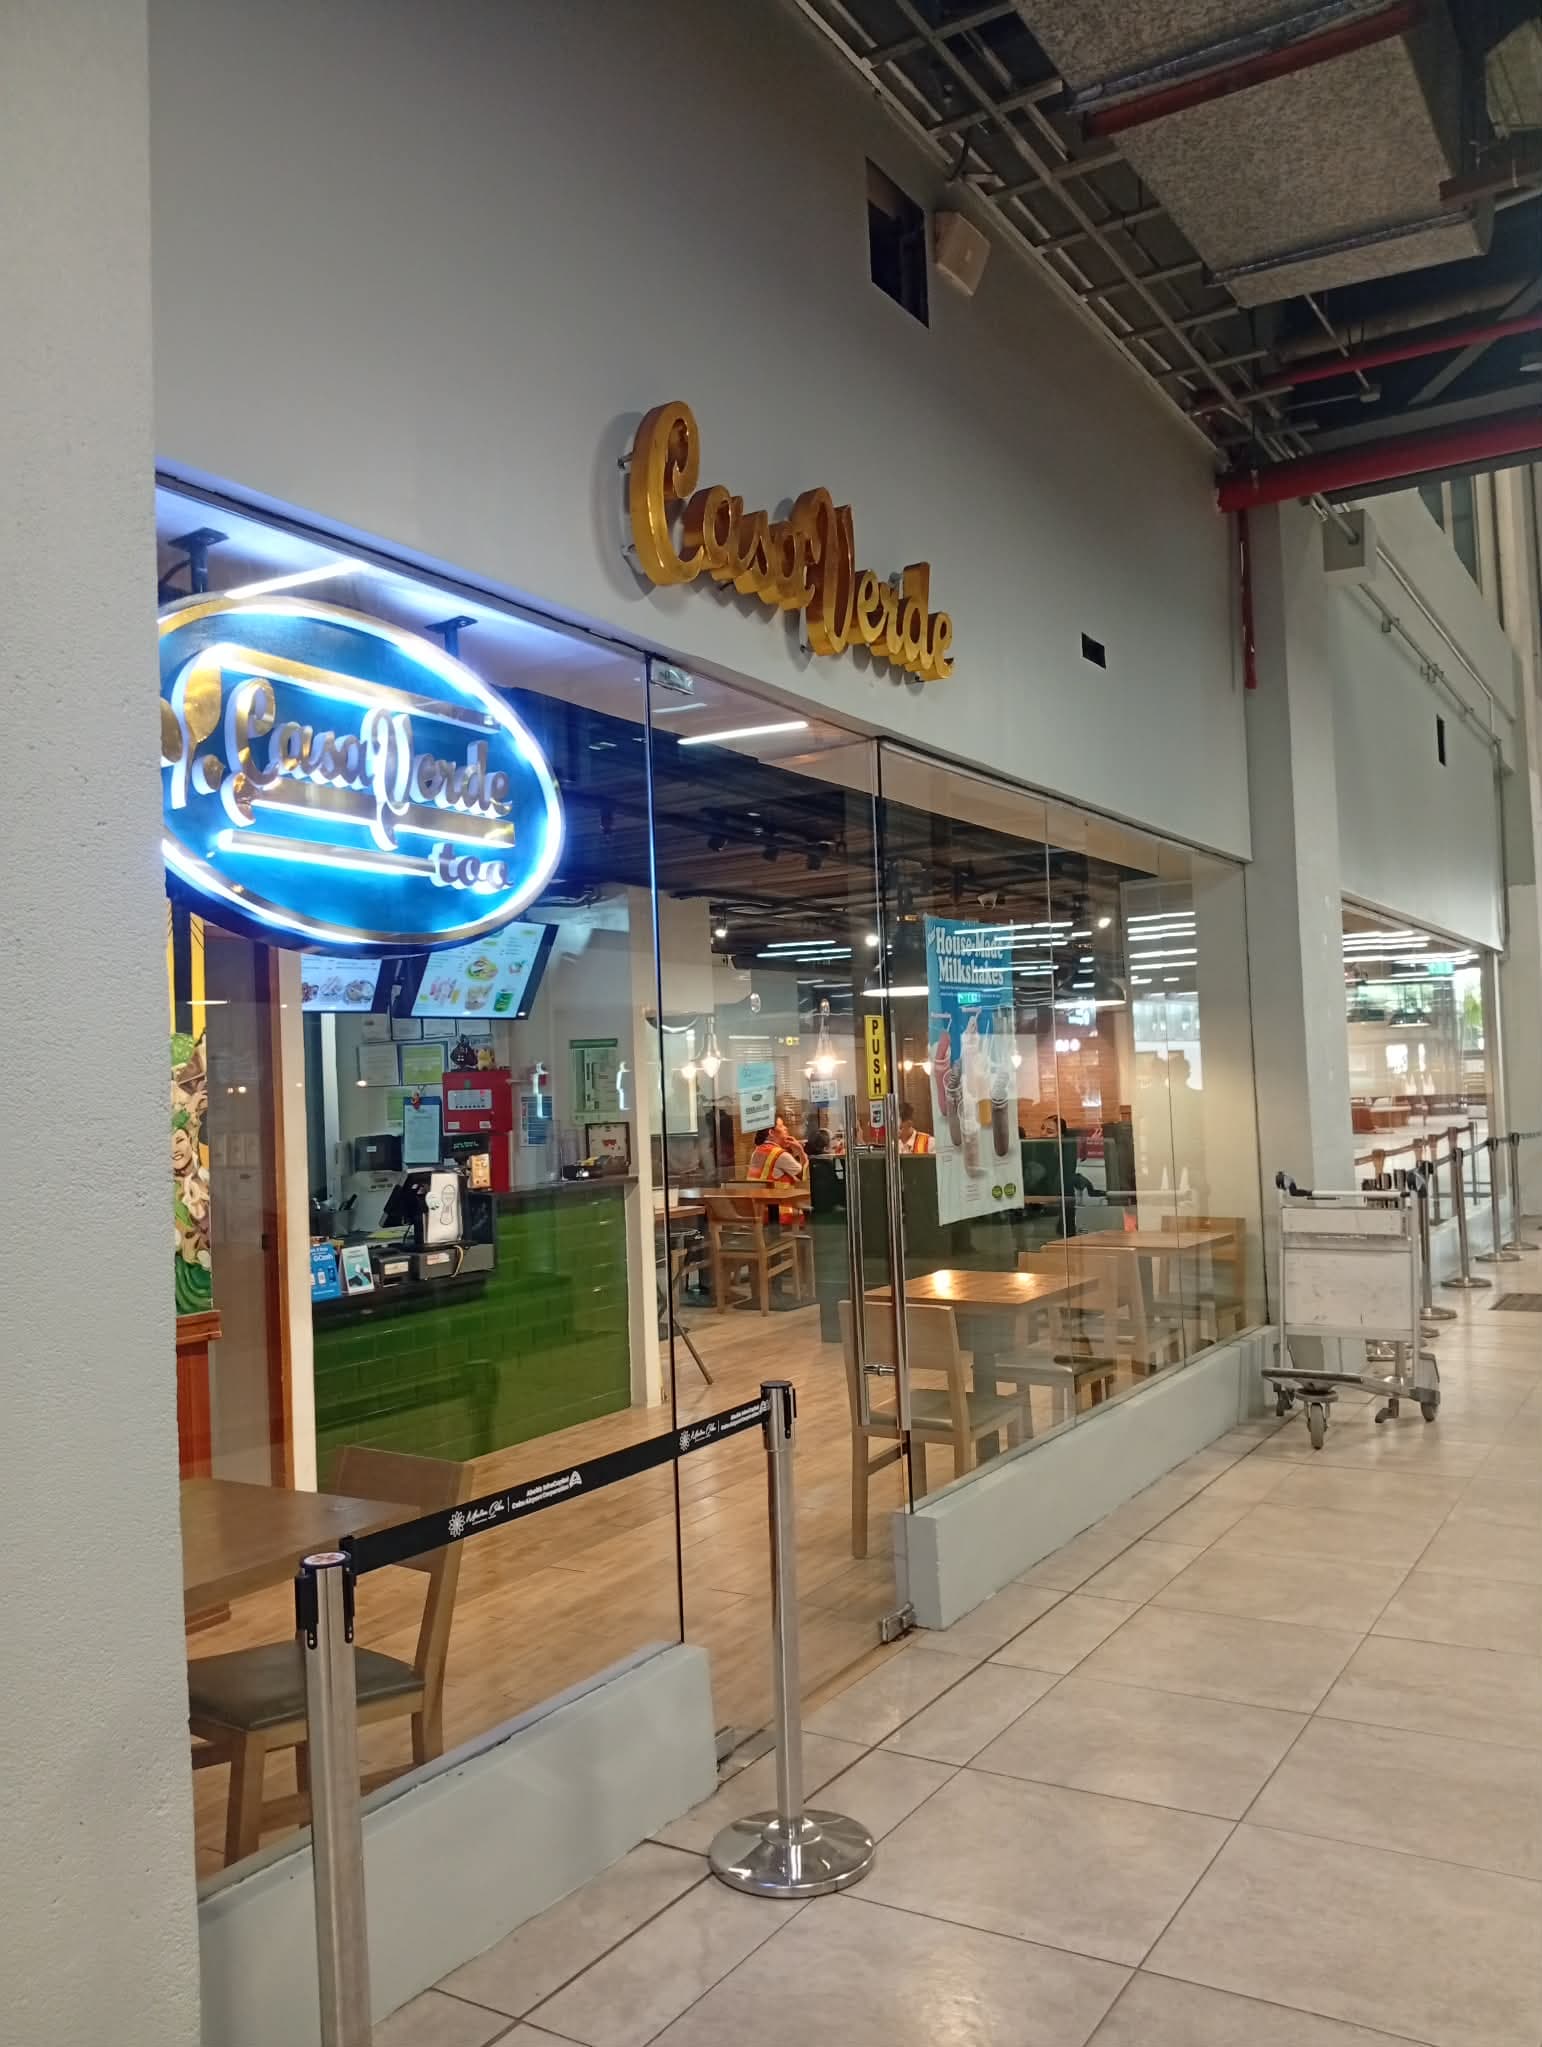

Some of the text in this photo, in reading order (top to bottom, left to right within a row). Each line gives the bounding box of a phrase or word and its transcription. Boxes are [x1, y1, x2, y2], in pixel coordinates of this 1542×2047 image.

[629, 400, 955, 682] Casa Verde
[220, 677, 513, 852] Casa Verde
[429, 842, 513, 894] too
[937, 955, 1004, 985] Milkshakes
[871, 1019, 882, 1094] PUSH
